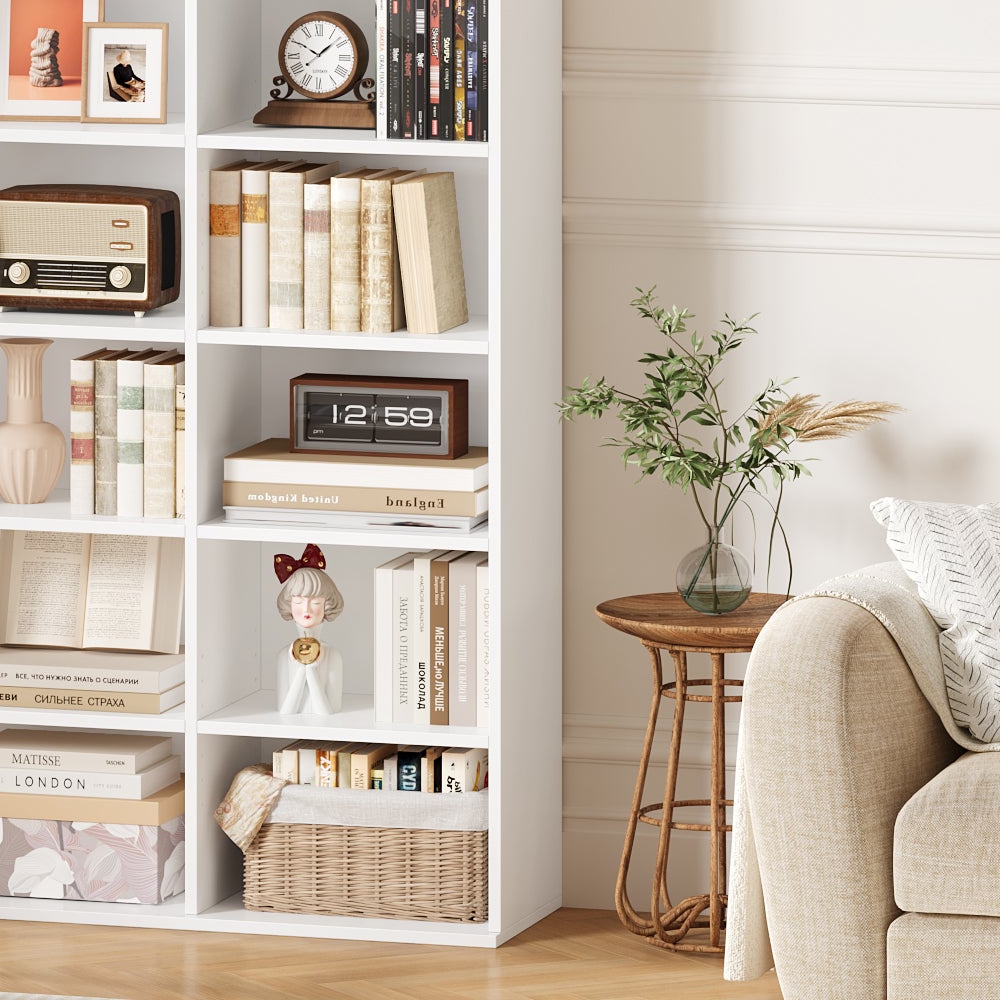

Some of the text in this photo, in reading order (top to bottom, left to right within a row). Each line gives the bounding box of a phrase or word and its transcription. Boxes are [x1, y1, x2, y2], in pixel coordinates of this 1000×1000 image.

[314, 23, 324, 37] XII
[338, 54, 351, 62] III
[332, 404, 434, 428] 12 59
[398, 596, 409, 705] ЗАБОТА О ПРЕДАННЫХ
[46, 674, 72, 682] НУЖНО
[73, 675, 94, 683] ЗНАТЬ
[102, 677, 139, 685] СЦЕНАРИИ
[417, 662, 426, 710] ШОКОЛАД
[34, 694, 126, 708] СИЛЬНЕЕ СТРАХА
[434, 680, 445, 712] ЛУЧШЕ
[11, 753, 61, 767] MATISSE
[15, 775, 86, 790] LONDON
